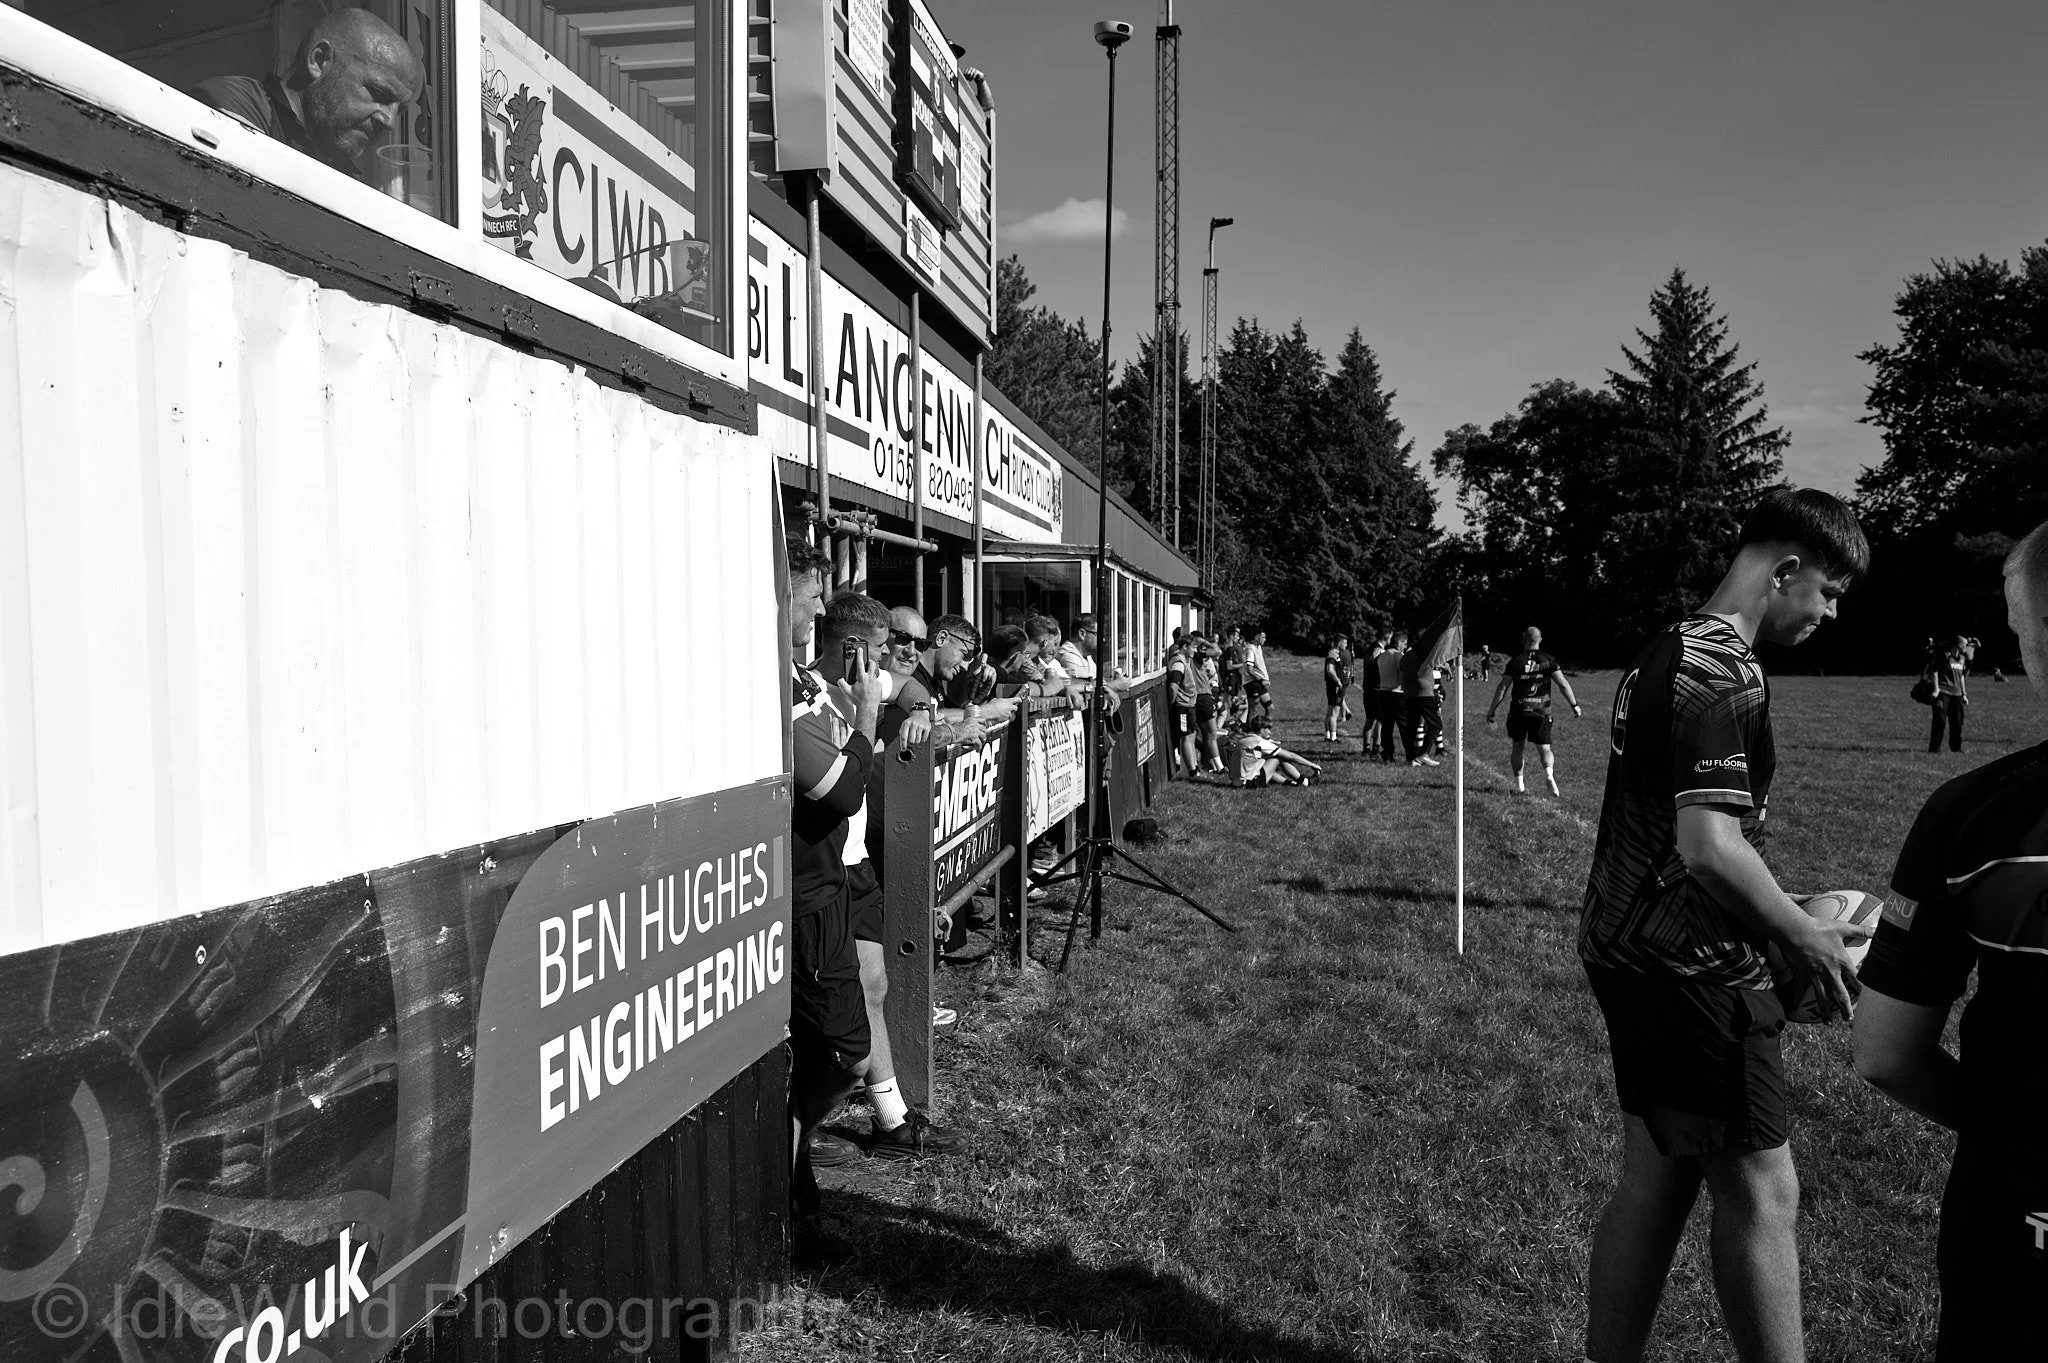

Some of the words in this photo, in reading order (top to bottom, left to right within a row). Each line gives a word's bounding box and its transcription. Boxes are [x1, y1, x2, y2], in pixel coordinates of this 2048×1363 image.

[913, 89, 934, 129] HOME
[505, 219, 518, 232] RFC
[874, 437, 914, 491] 0155
[929, 462, 973, 512] 820495
[1012, 452, 1034, 505] RUGBY
[1035, 469, 1051, 514] CLUB
[934, 738, 1001, 845] EMERGE
[1702, 759, 1713, 767] HJ
[964, 822, 995, 870] PRINT
[540, 897, 627, 1009] BEN
[641, 841, 769, 955] HUGHES
[539, 920, 784, 1133] ENGINEERING
